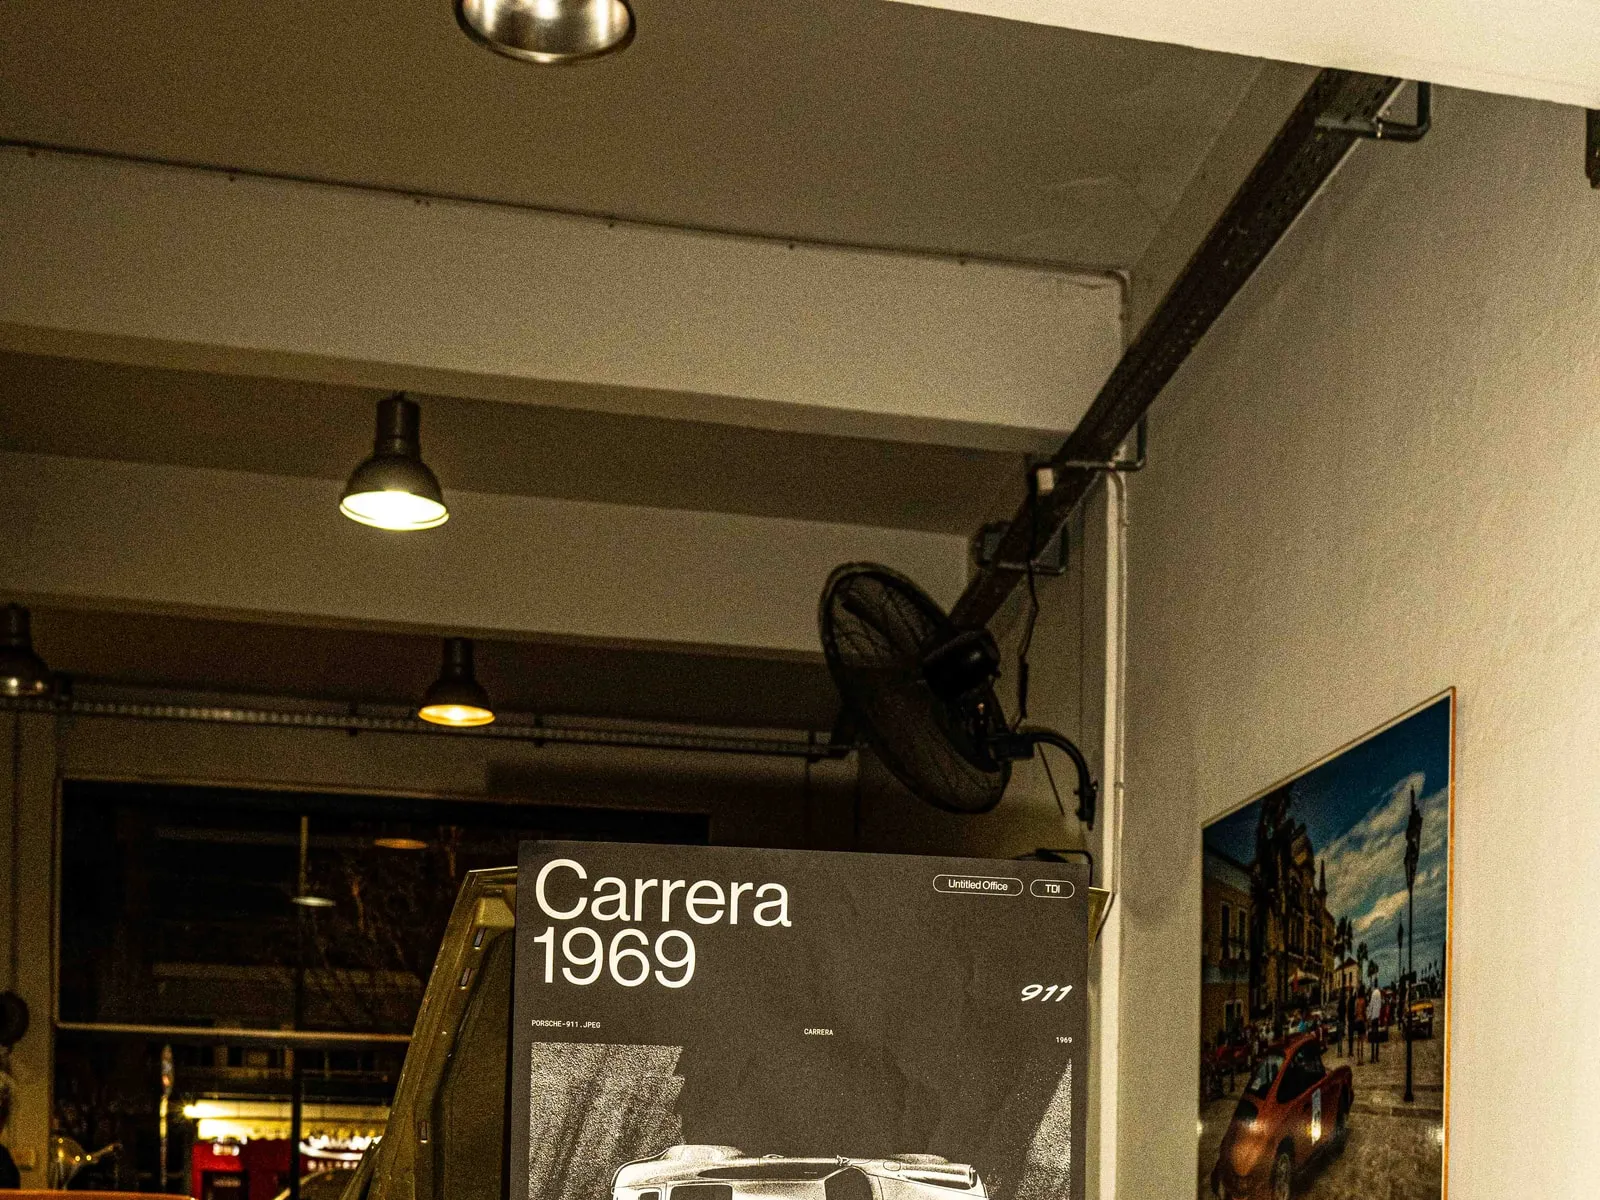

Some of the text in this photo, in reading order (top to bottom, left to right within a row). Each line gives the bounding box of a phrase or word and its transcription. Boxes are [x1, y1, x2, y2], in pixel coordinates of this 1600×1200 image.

[948, 879, 1008, 892] Untitled Office
[1044, 883, 1061, 894] TDI
[535, 858, 793, 929] Carrera
[533, 926, 696, 989] 1969
[1020, 983, 1073, 1003] 911
[531, 1019, 601, 1029] PORSCHE-911.JPEG
[803, 1027, 834, 1036] CARRERA
[1055, 1036, 1073, 1044] 1969
